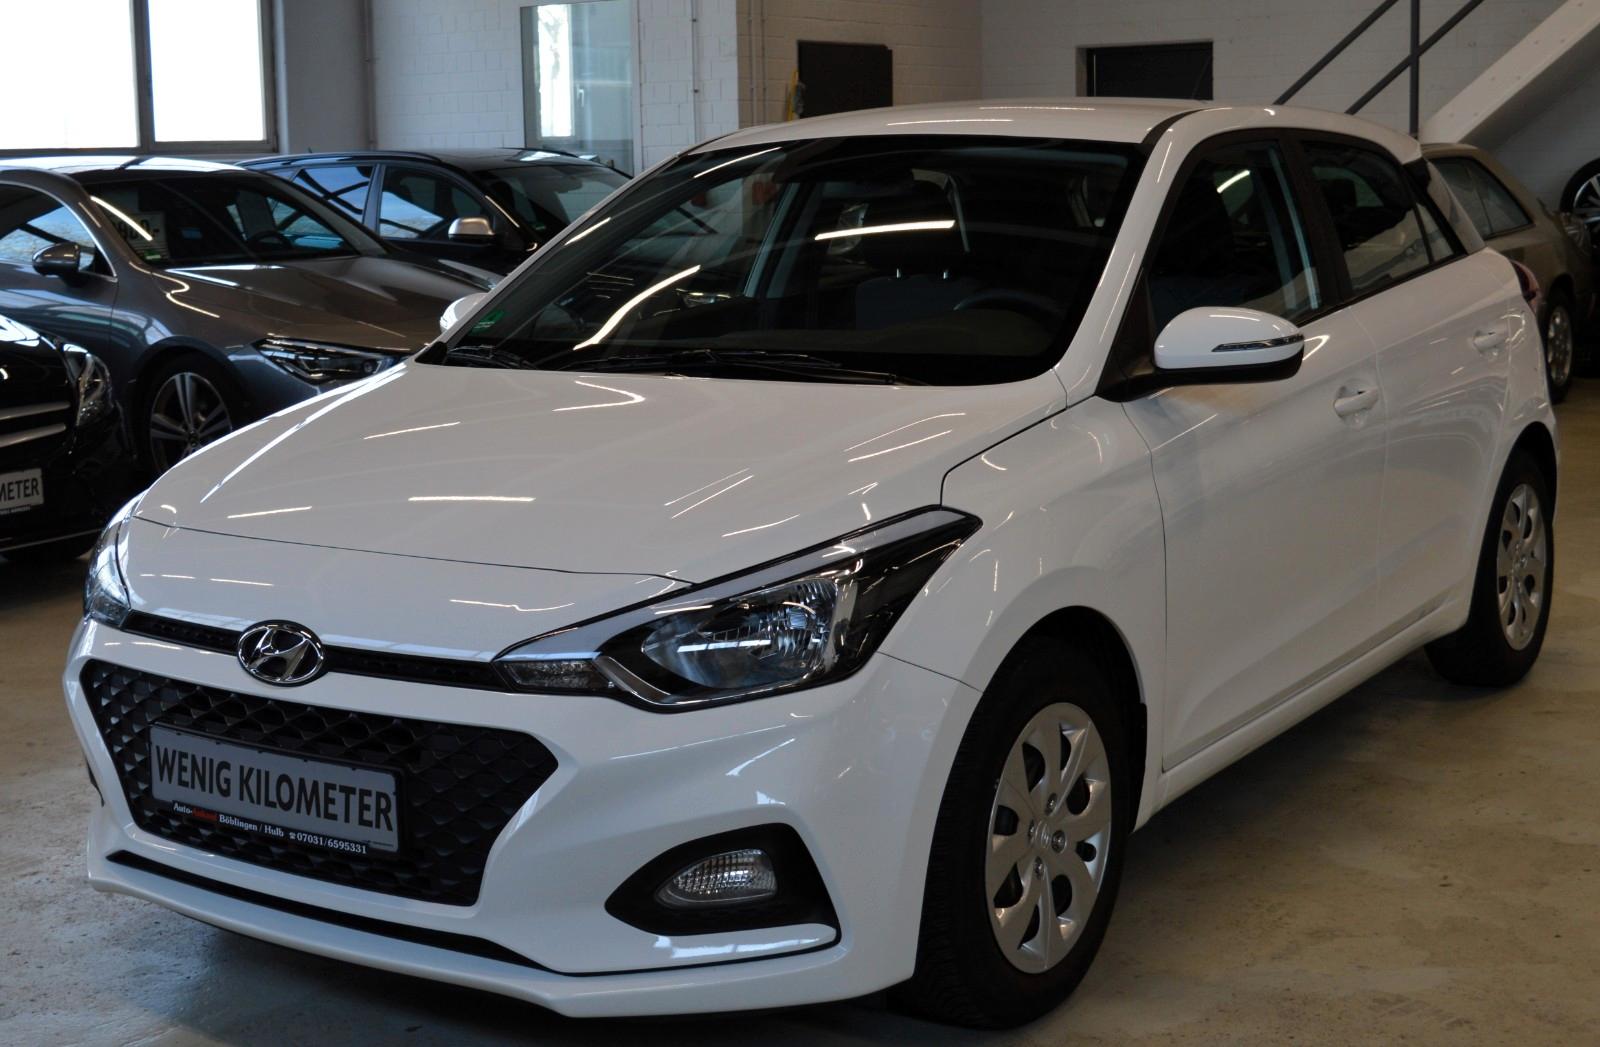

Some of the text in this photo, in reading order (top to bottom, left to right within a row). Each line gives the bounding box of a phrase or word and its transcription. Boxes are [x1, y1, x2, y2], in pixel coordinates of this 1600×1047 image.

[155, 745, 394, 832] WENIG KILOMETER
[219, 814, 258, 832] Böblingen
[264, 824, 284, 838] Hulb
[297, 832, 367, 854] 07031/6595331
